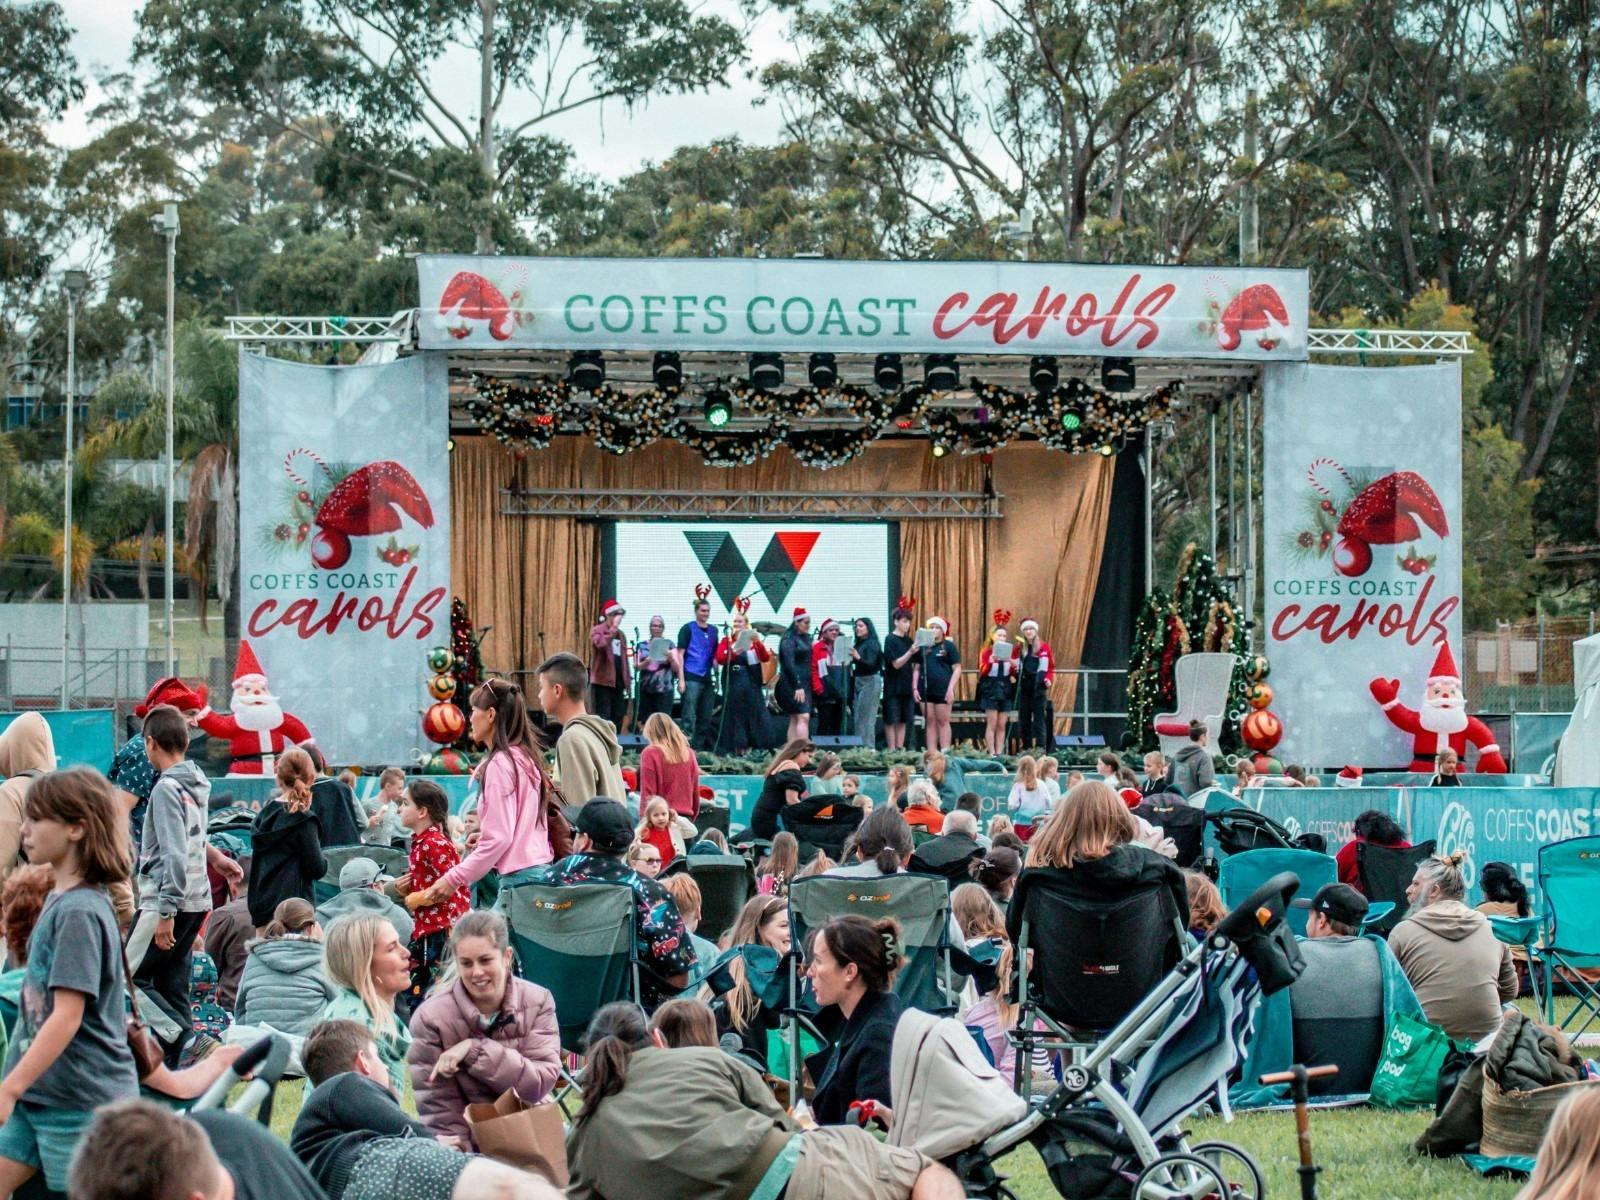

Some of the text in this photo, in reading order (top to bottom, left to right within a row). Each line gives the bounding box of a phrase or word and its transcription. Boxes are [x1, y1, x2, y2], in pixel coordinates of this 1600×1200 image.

[564, 273, 1177, 350] COFFS COAST carols
[249, 572, 399, 590] COFFS COAST
[1273, 579, 1418, 597] COFFS COAST
[248, 565, 447, 640] carols
[1271, 574, 1460, 646] carols
[1391, 1024, 1413, 1052] bag
[1379, 1060, 1407, 1077] pod
